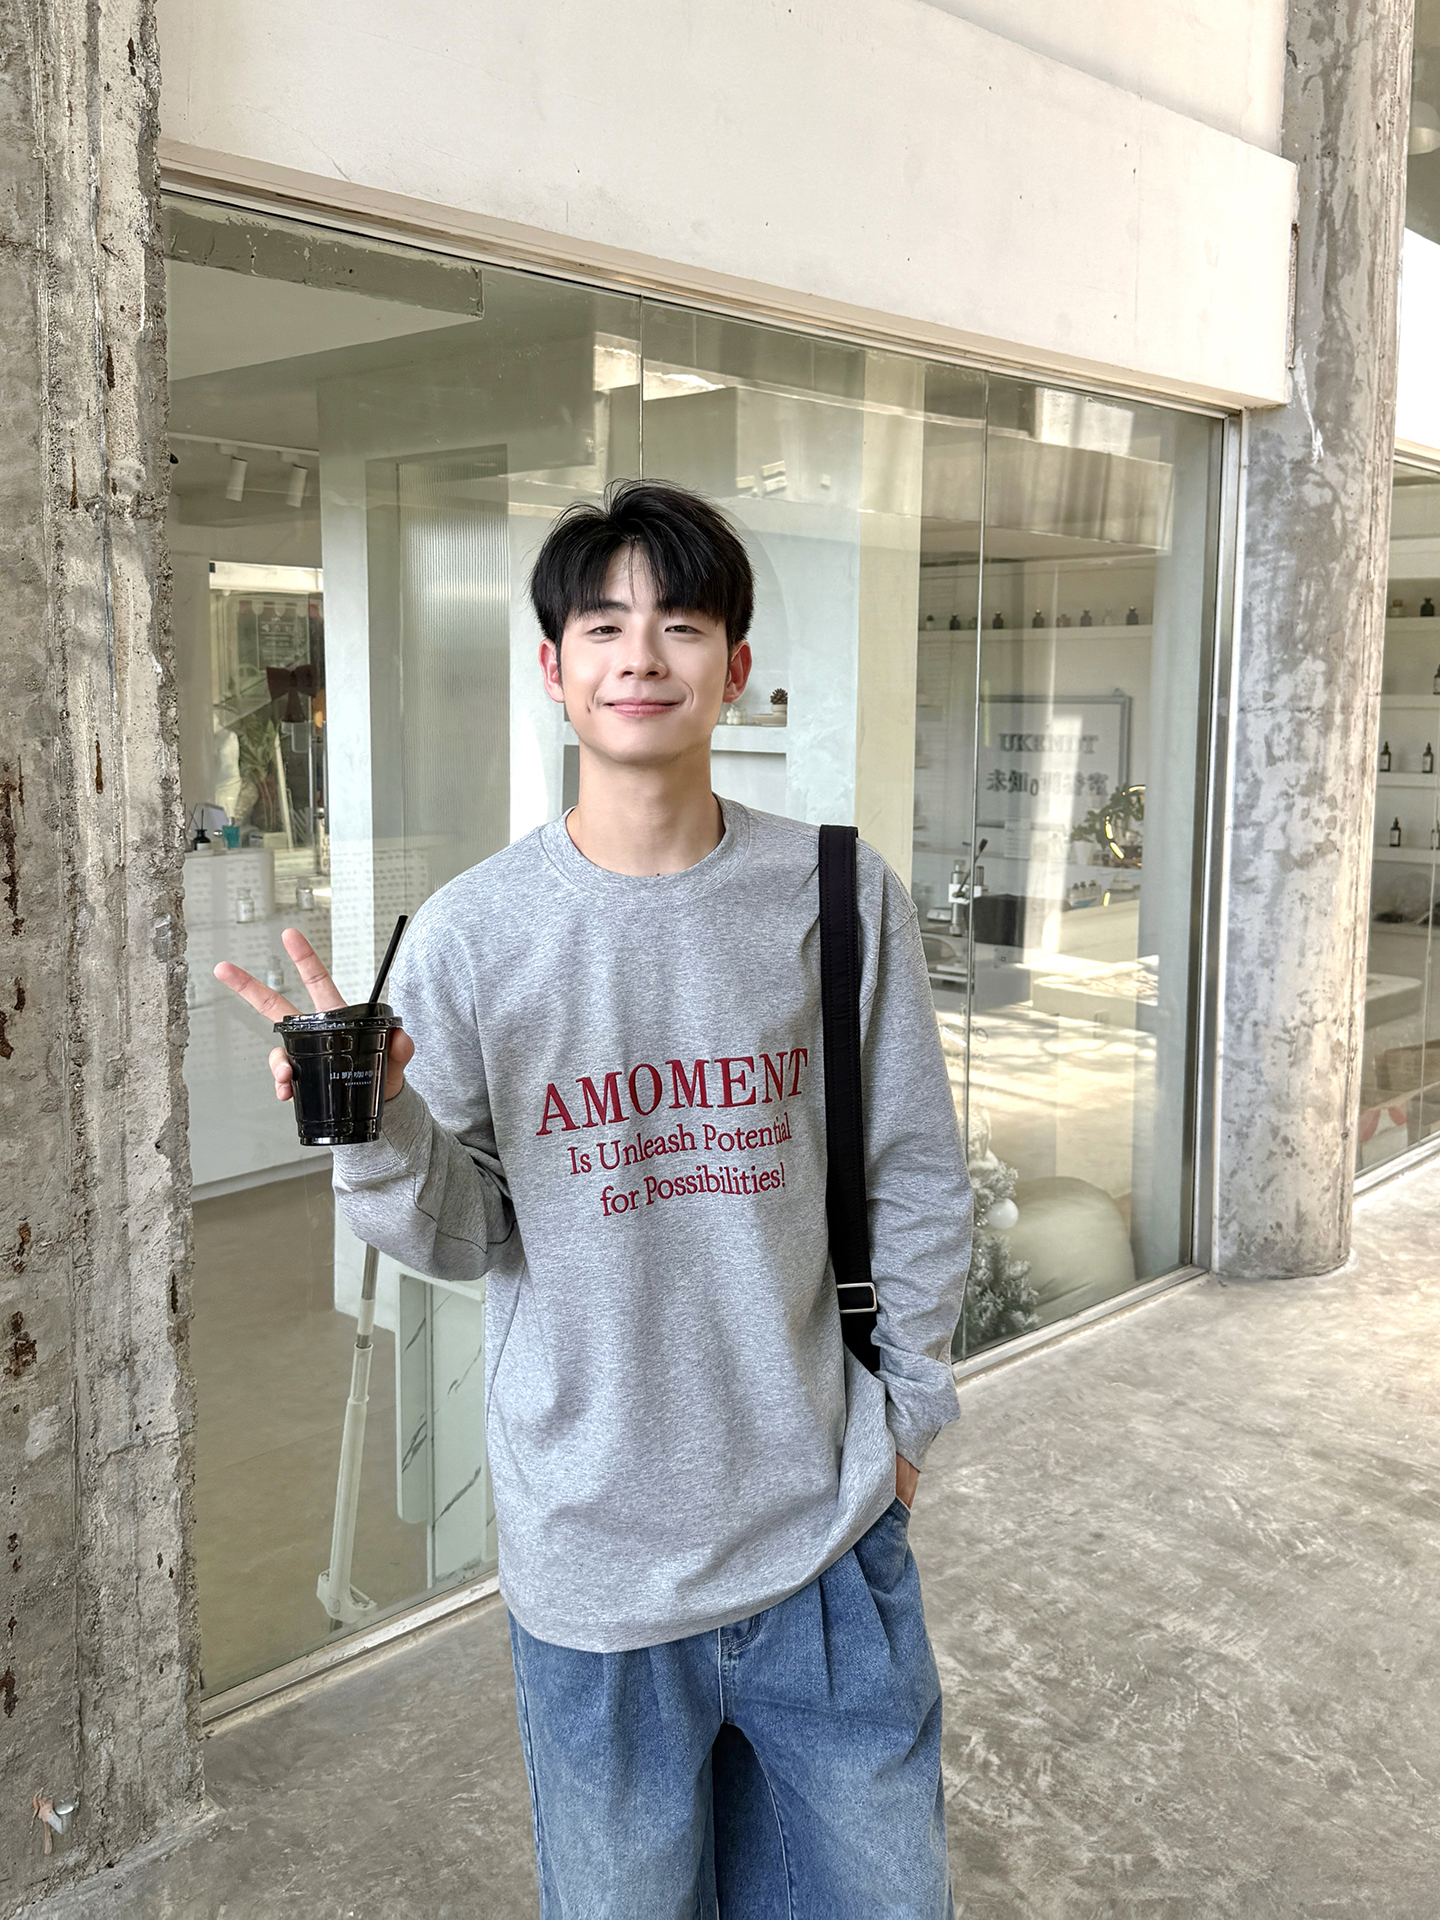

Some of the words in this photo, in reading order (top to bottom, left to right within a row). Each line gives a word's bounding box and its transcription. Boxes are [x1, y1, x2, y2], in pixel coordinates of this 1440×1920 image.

[567, 1146, 592, 1175] Is
[597, 1123, 696, 1171] Unleash
[702, 1112, 793, 1152] Potential
[600, 1186, 639, 1217] for
[643, 1162, 787, 1206] Possibilities!
